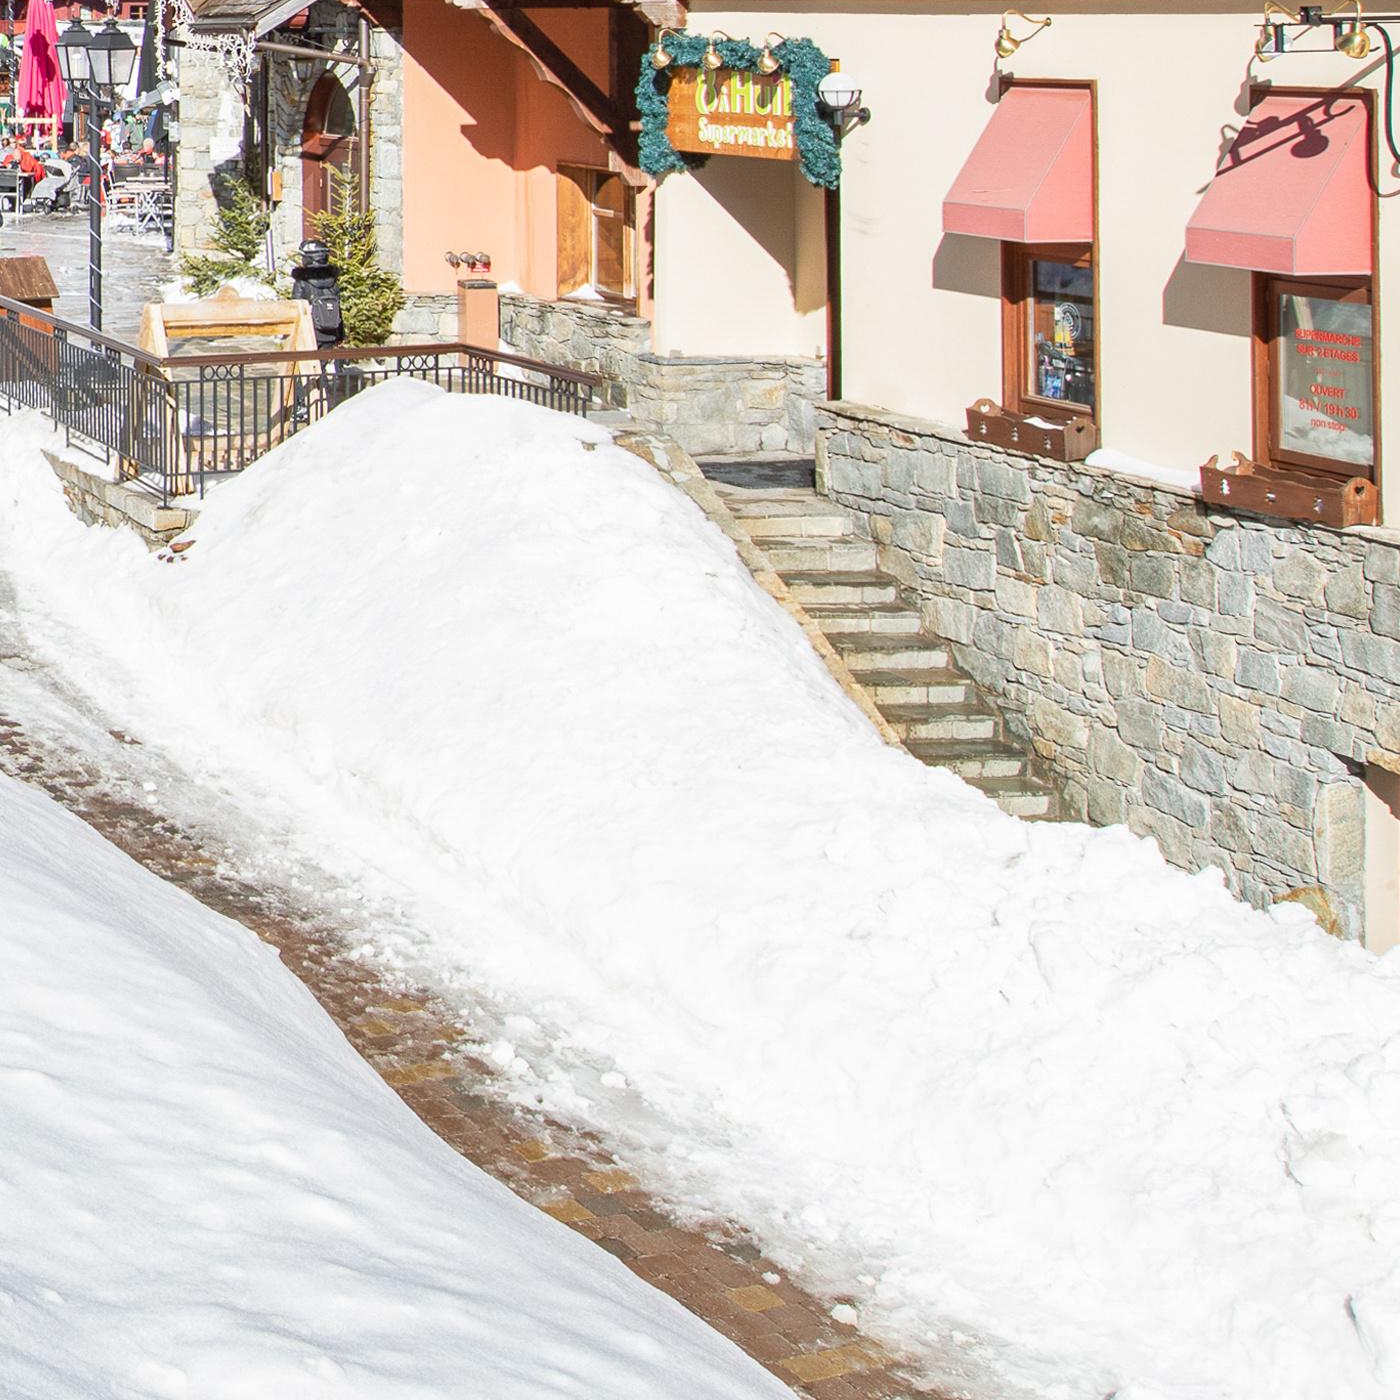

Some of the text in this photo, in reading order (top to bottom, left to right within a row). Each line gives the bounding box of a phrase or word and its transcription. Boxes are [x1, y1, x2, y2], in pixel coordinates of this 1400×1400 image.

[698, 117, 793, 149] Supermarket
[1297, 344, 1314, 356] SUR
[1310, 385, 1344, 399] OUVERT
[1311, 419, 1325, 428] non
